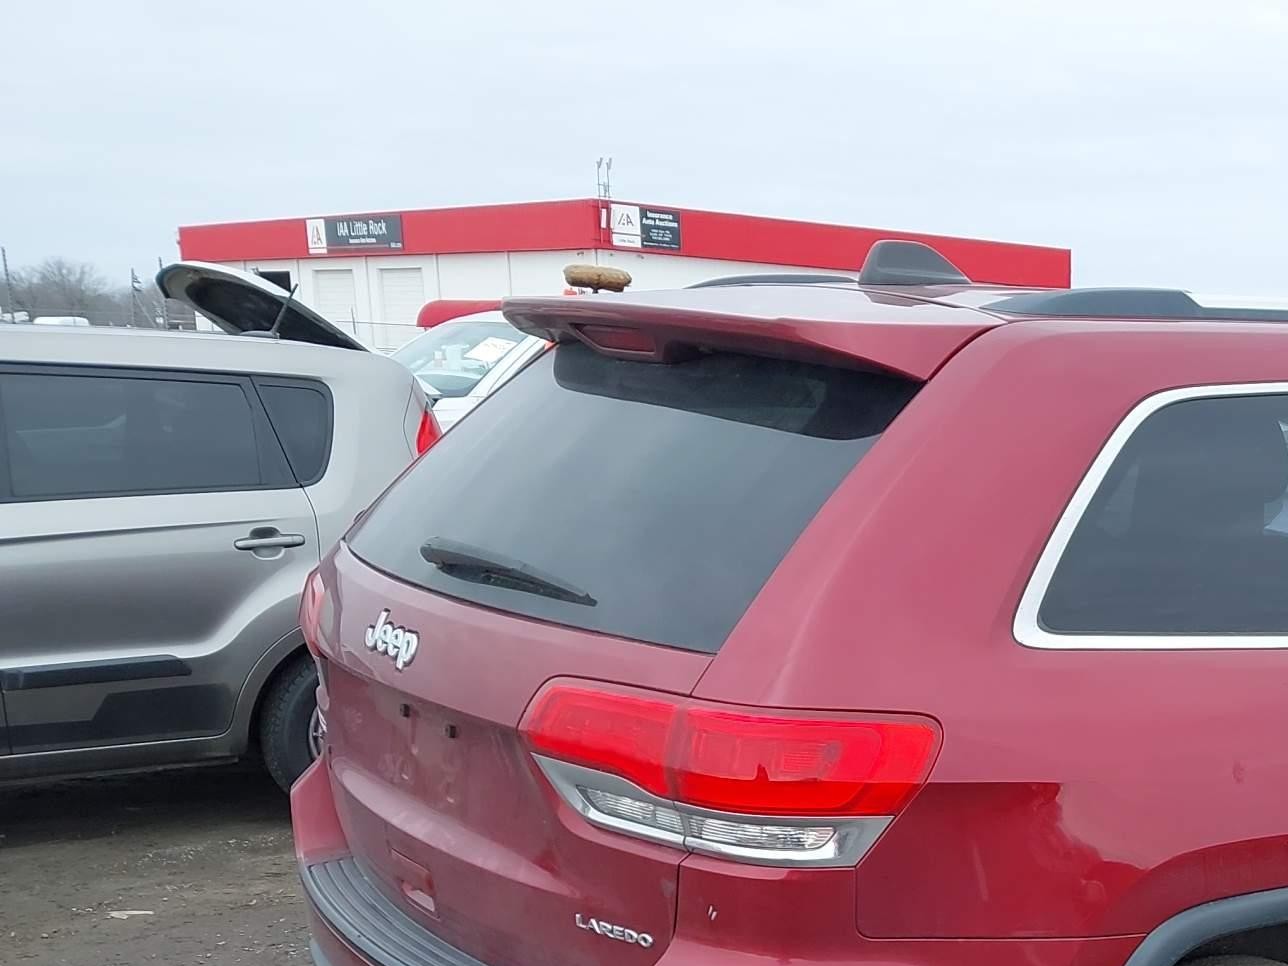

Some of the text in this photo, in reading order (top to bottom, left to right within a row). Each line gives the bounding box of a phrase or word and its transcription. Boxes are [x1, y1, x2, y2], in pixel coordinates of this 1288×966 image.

[336, 219, 387, 237] IAA Little Rock
[365, 608, 419, 672] Jeep
[575, 913, 654, 948] LAREDO
